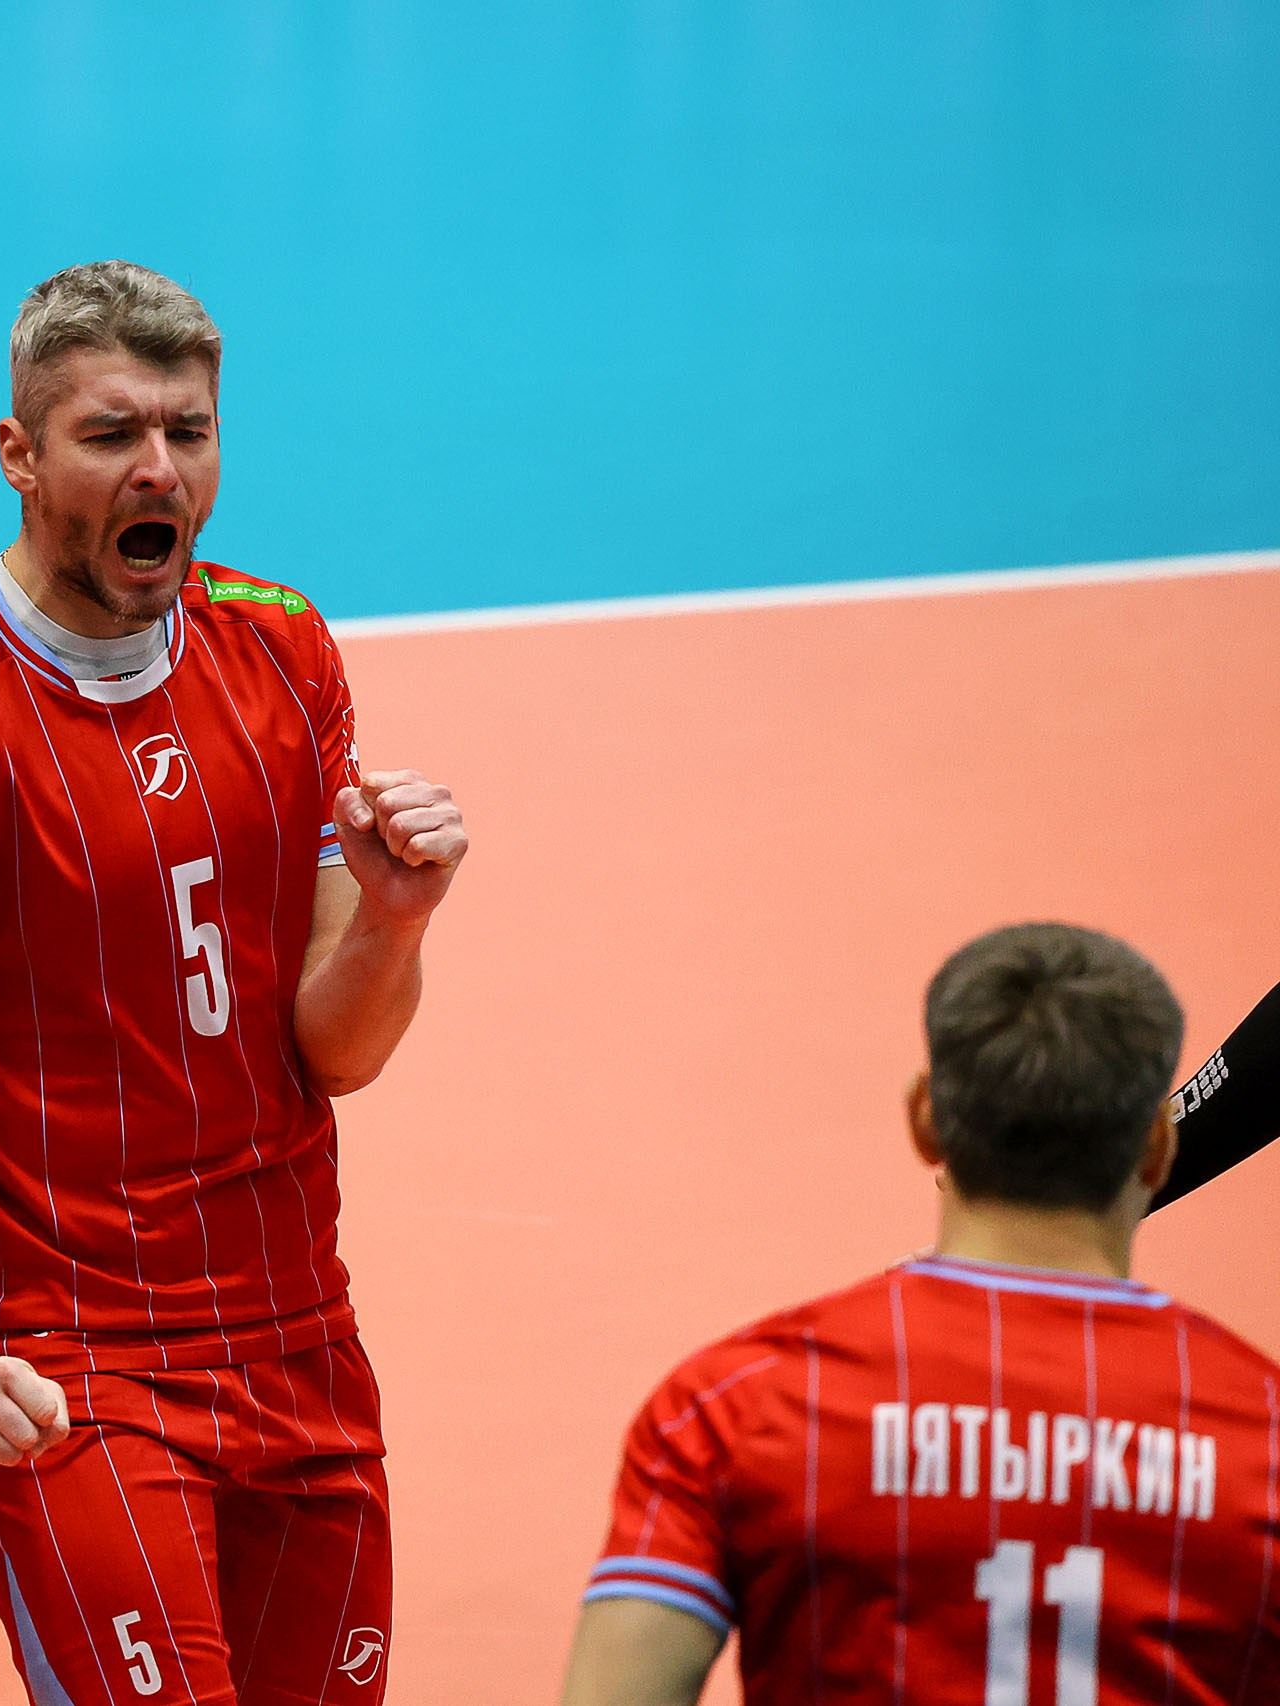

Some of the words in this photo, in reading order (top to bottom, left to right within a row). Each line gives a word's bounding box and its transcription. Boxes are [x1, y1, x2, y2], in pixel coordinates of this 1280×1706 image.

[171, 856, 230, 1036] 5
[872, 1402, 1216, 1521] ПЯТЫРКИН
[112, 1610, 162, 1695] 5
[975, 1539, 1104, 1706] 11
